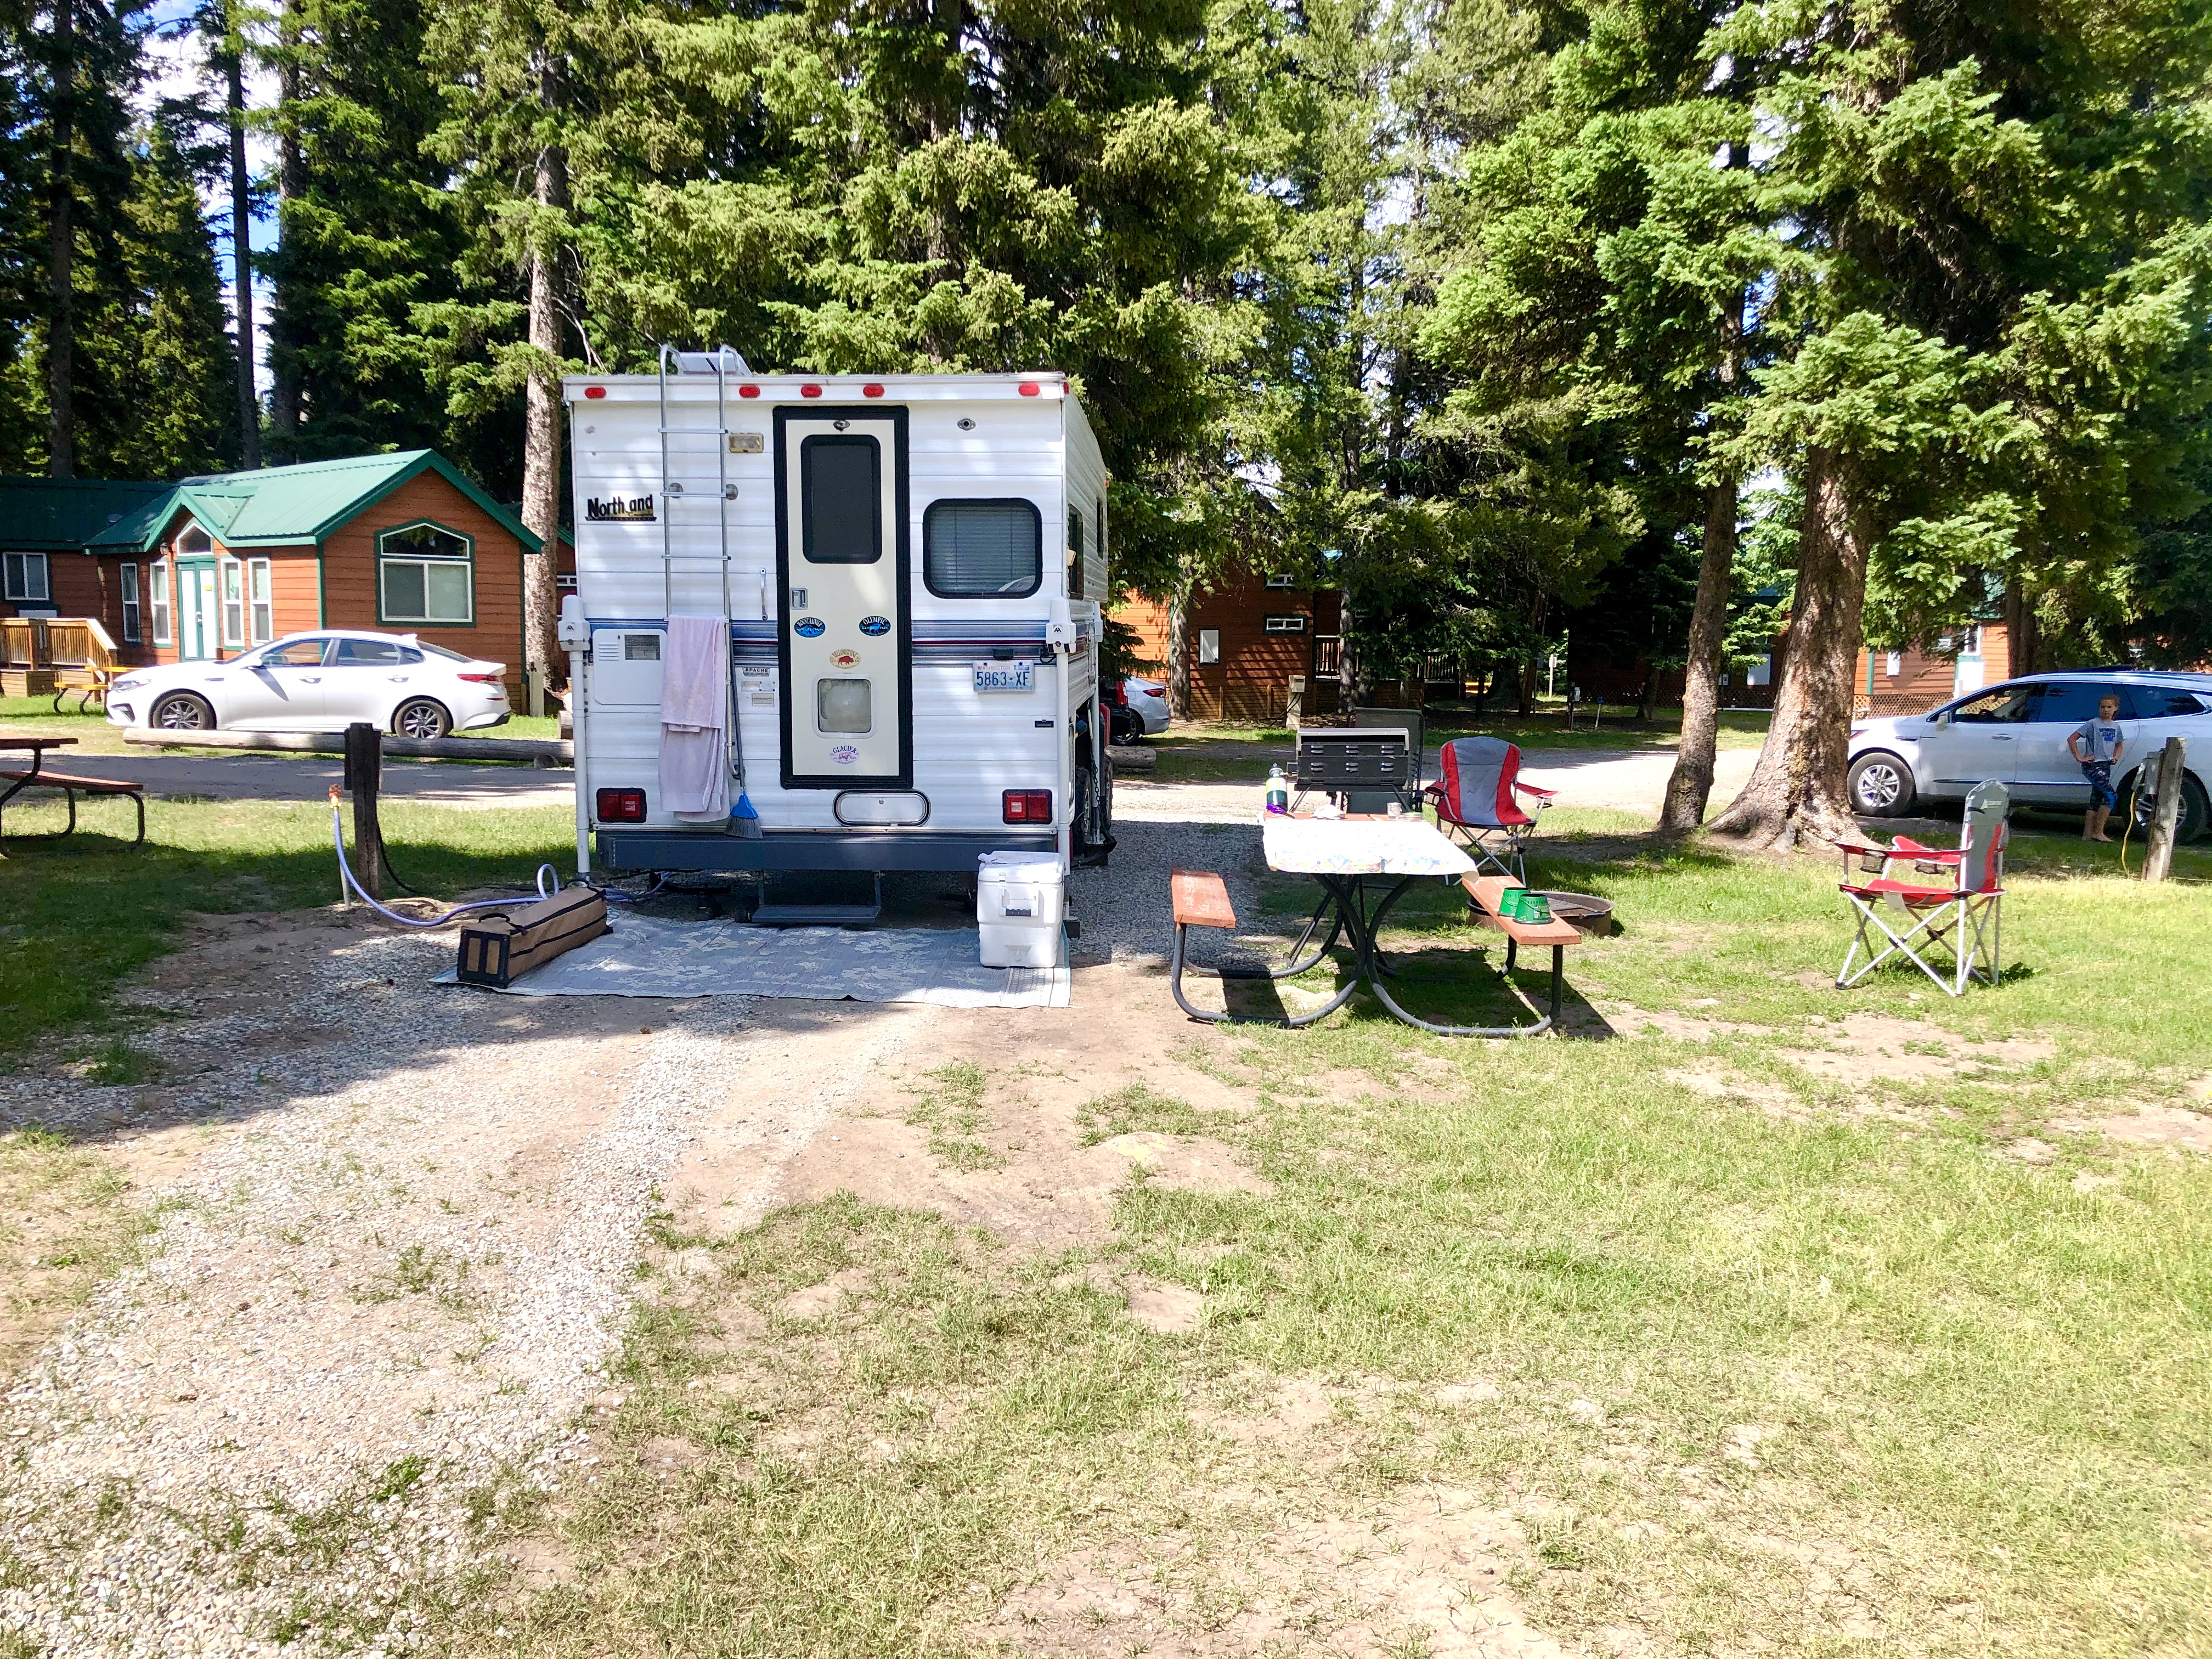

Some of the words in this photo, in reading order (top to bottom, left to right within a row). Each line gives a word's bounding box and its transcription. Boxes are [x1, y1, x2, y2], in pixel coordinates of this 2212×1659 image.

[587, 494, 653, 517] Northand
[796, 618, 809, 627] MOUNT
[863, 616, 887, 625] OLYMPIC
[831, 649, 859, 658] YELLOWSTONE
[977, 671, 1030, 686] 5863-XF
[832, 745, 857, 754] GLACIER
